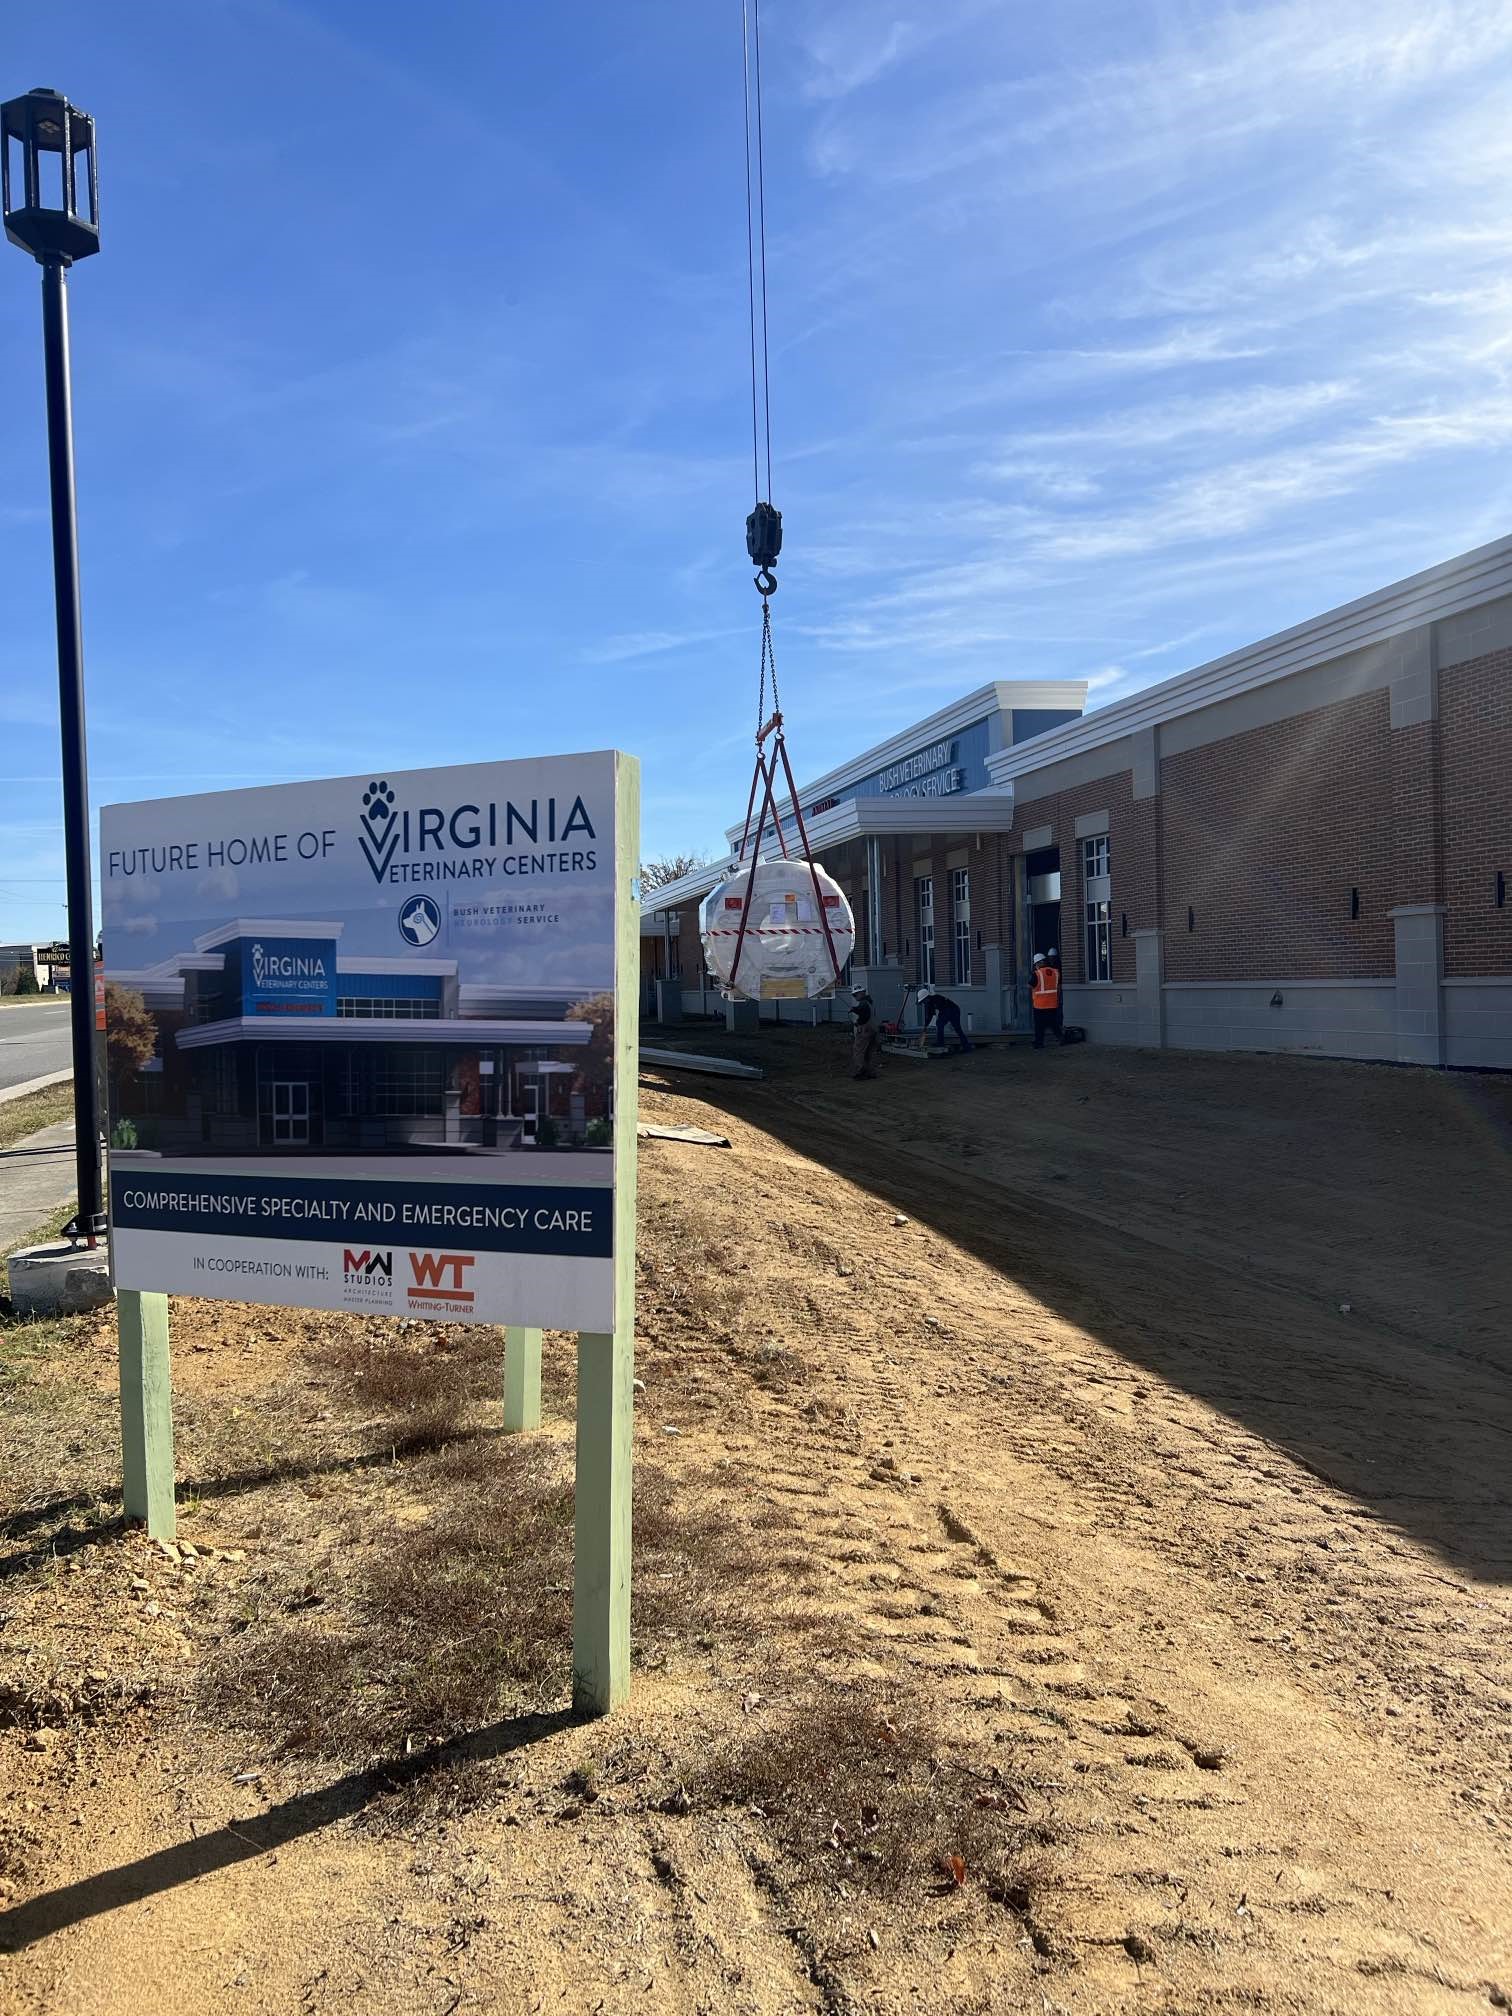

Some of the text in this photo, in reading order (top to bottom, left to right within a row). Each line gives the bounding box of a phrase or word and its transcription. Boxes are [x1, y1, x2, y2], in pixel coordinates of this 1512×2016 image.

[880, 766, 899, 793] BUSH
[899, 741, 952, 783] VETERINARY
[922, 768, 960, 798] SERVICE
[359, 795, 596, 855] VIRGINIA
[109, 830, 336, 877] FUTURE HOME OF
[358, 834, 597, 884] VETERINARY CENTERS
[453, 904, 545, 916] BUSH VETERINARY
[517, 914, 559, 924] SERVICE
[253, 956, 326, 977] VIRGINIA
[298, 980, 329, 989] CENTERS
[123, 1190, 593, 1232] COMPREHENSIVE SPECIALTY AND EMERGENCY CARE
[193, 1257, 329, 1280] IN COOPERATION WITH:
[344, 1274, 393, 1287] STUDIOS
[408, 1252, 475, 1289] WT
